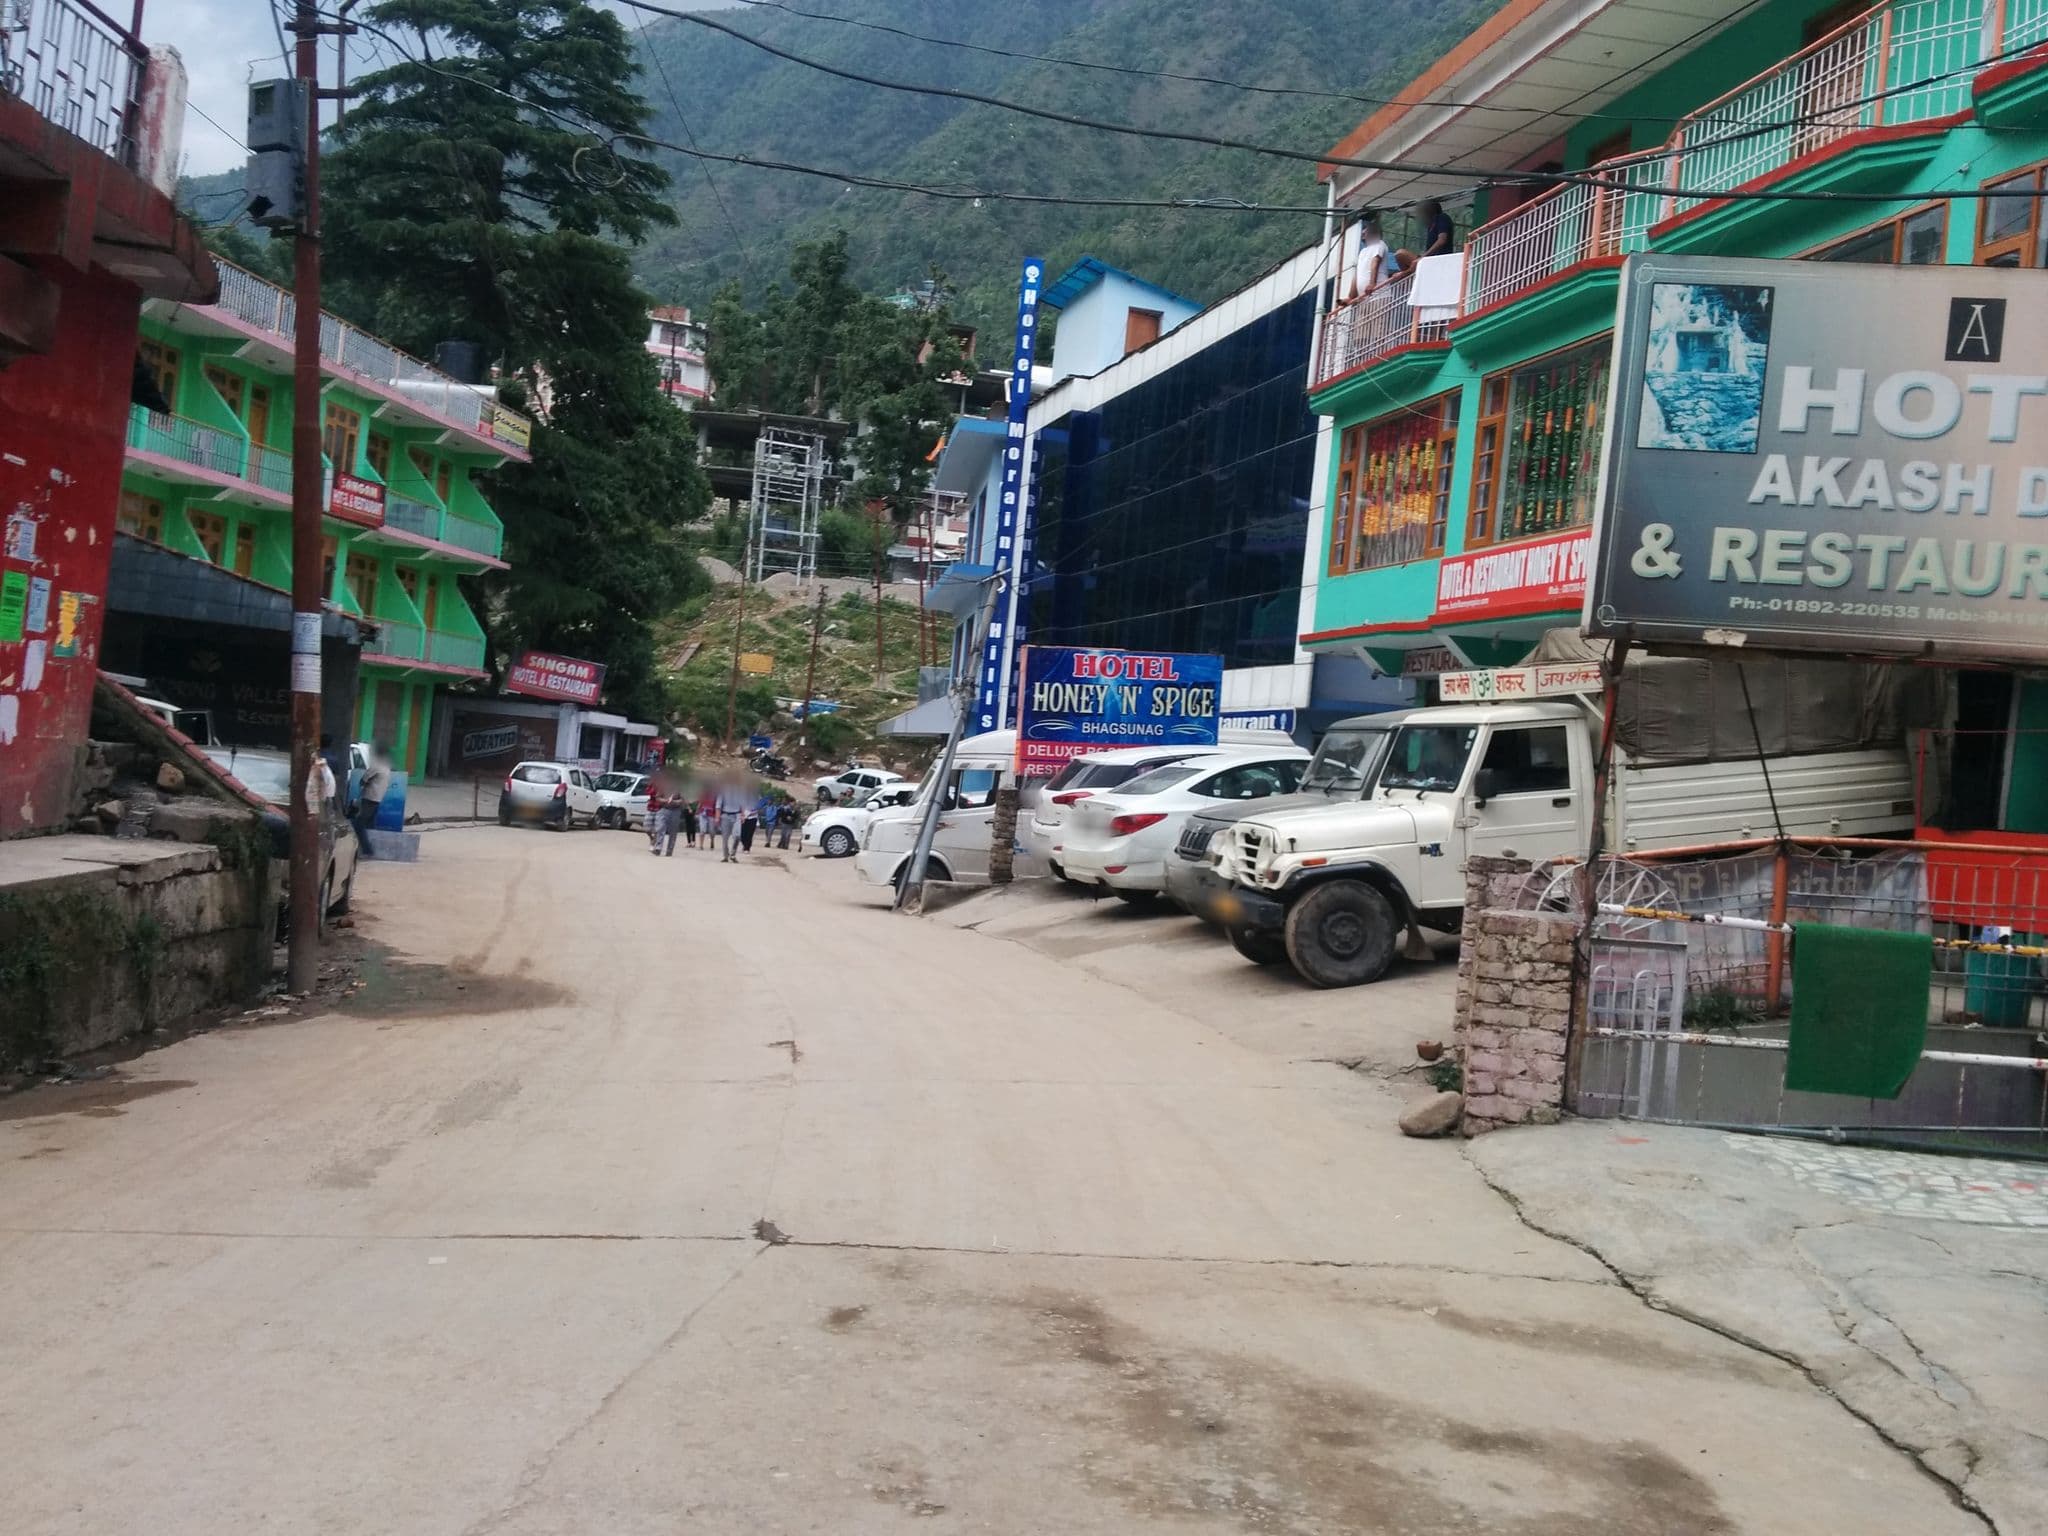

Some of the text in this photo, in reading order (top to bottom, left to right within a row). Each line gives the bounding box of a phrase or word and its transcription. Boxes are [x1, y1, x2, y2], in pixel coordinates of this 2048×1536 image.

[1778, 364, 2048, 443] HOT
[1747, 454, 1993, 517] AKASH
[981, 289, 1037, 728] Hotel Morain Hills
[1630, 523, 1684, 580] &
[1439, 561, 1466, 600] HOTEL
[1464, 564, 1472, 597] &
[1471, 549, 1528, 595] RESTAURANT
[1525, 543, 1559, 587] HONEY
[1729, 596, 1921, 619] Ph:-01892-220535
[513, 667, 597, 697] HOTEL & RESTAURANT
[529, 656, 590, 678] SANGAM
[1073, 653, 1179, 681] HOTEL
[1032, 682, 1215, 718] HONEY 'N' SPICE
[1081, 722, 1164, 736] BHAGSUNAG
[1027, 744, 1083, 758] DELUXE
